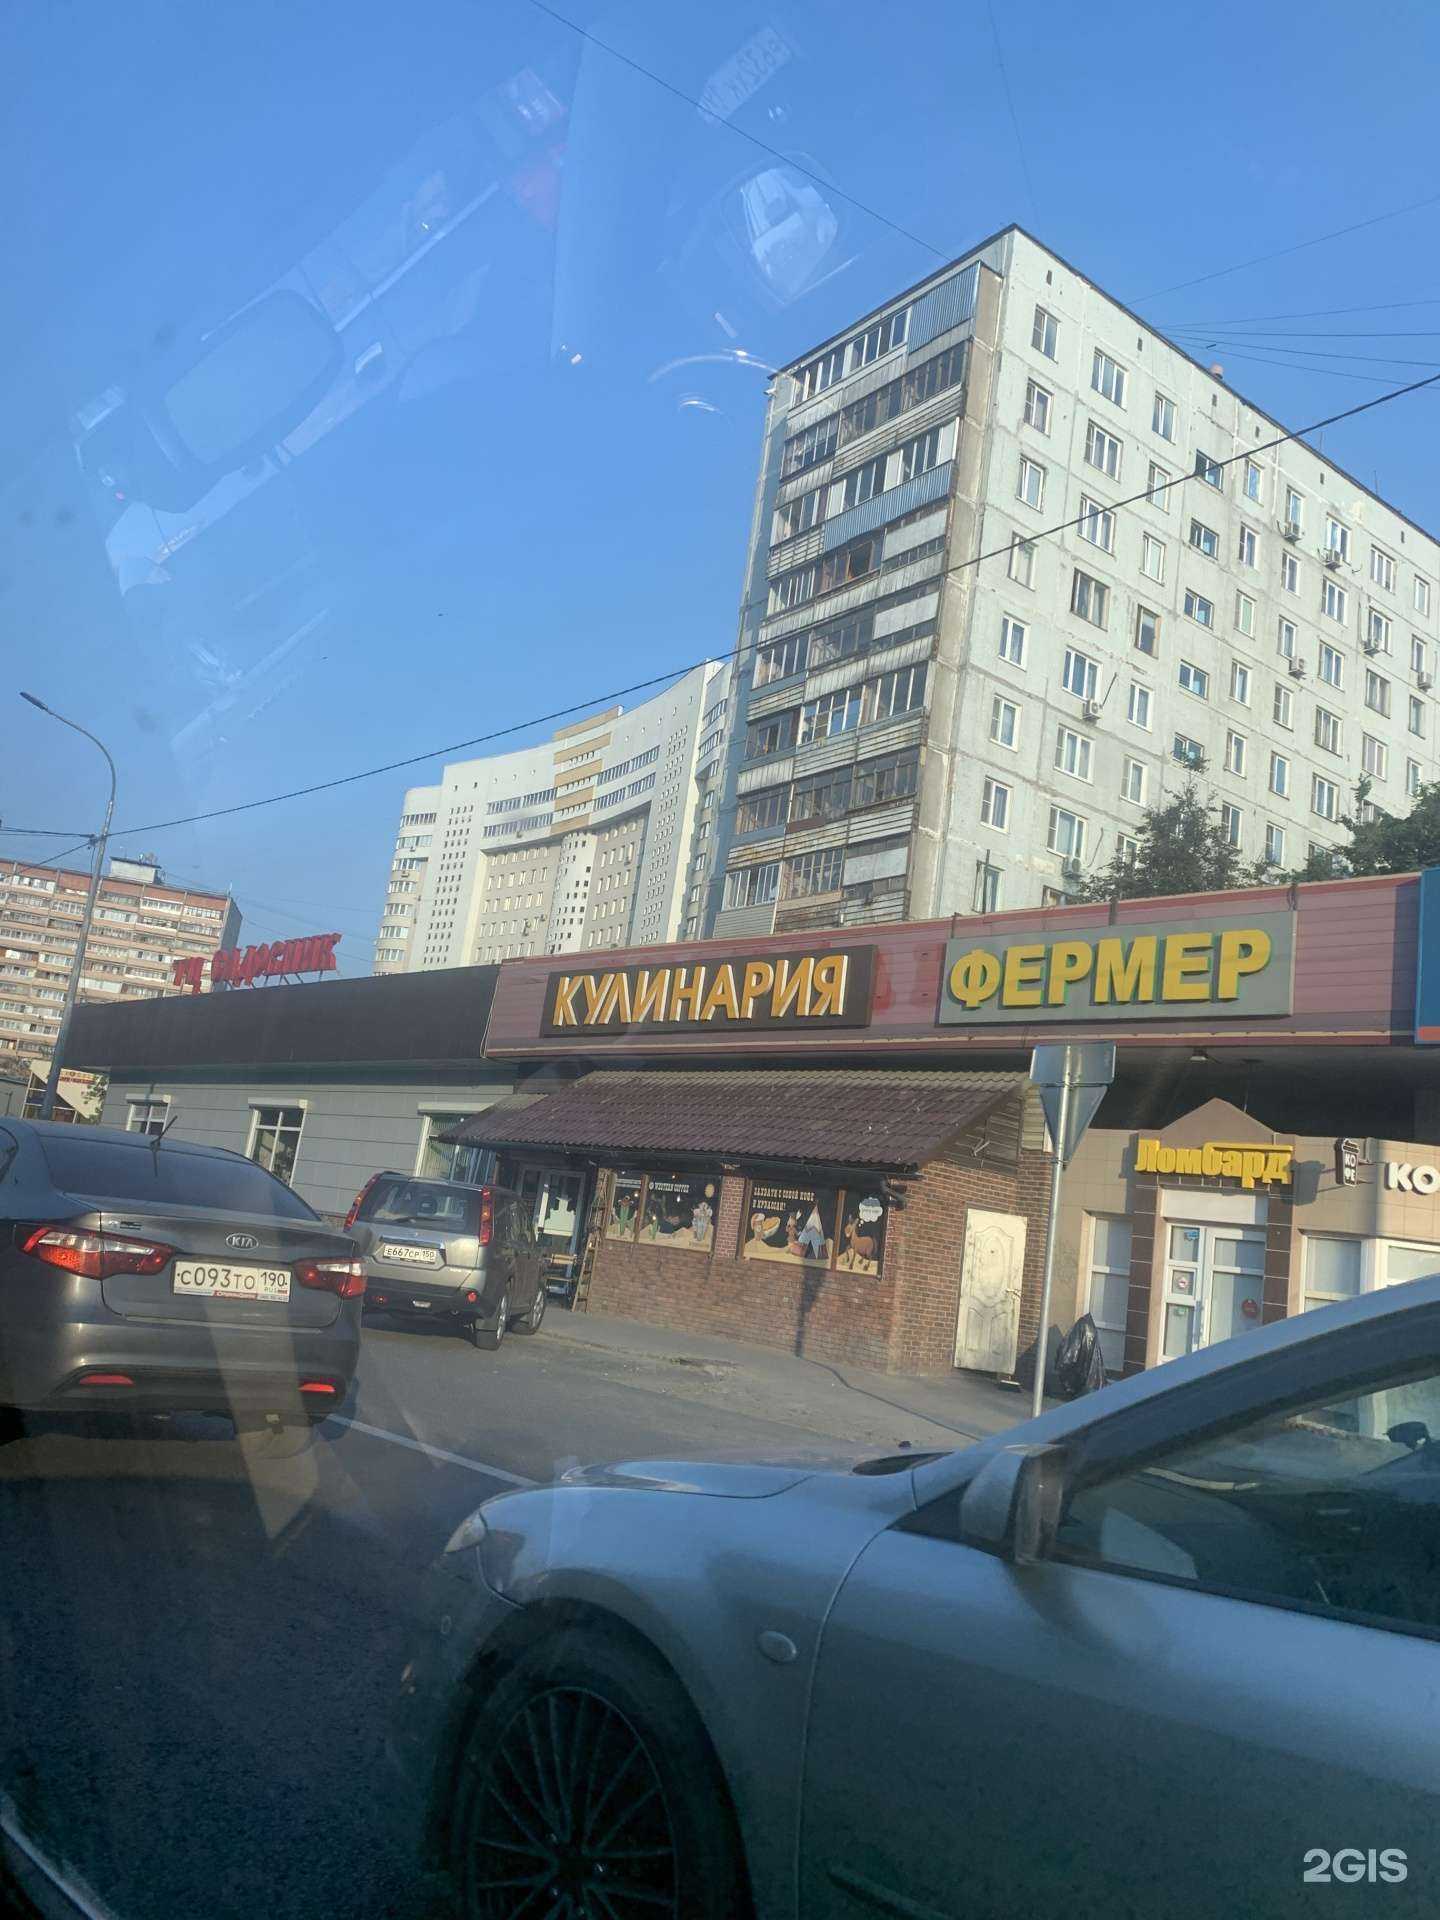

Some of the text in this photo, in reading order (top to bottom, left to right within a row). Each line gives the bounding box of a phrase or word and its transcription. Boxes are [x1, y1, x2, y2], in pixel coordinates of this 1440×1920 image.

[553, 955, 848, 1026] КУЛИНАРИЯ
[949, 928, 1272, 1009] ФЕРМЕР
[1134, 1139, 1293, 1189] Ломбард
[231, 1236, 254, 1248] KIA
[180, 1266, 286, 1290] С093ТО 190
